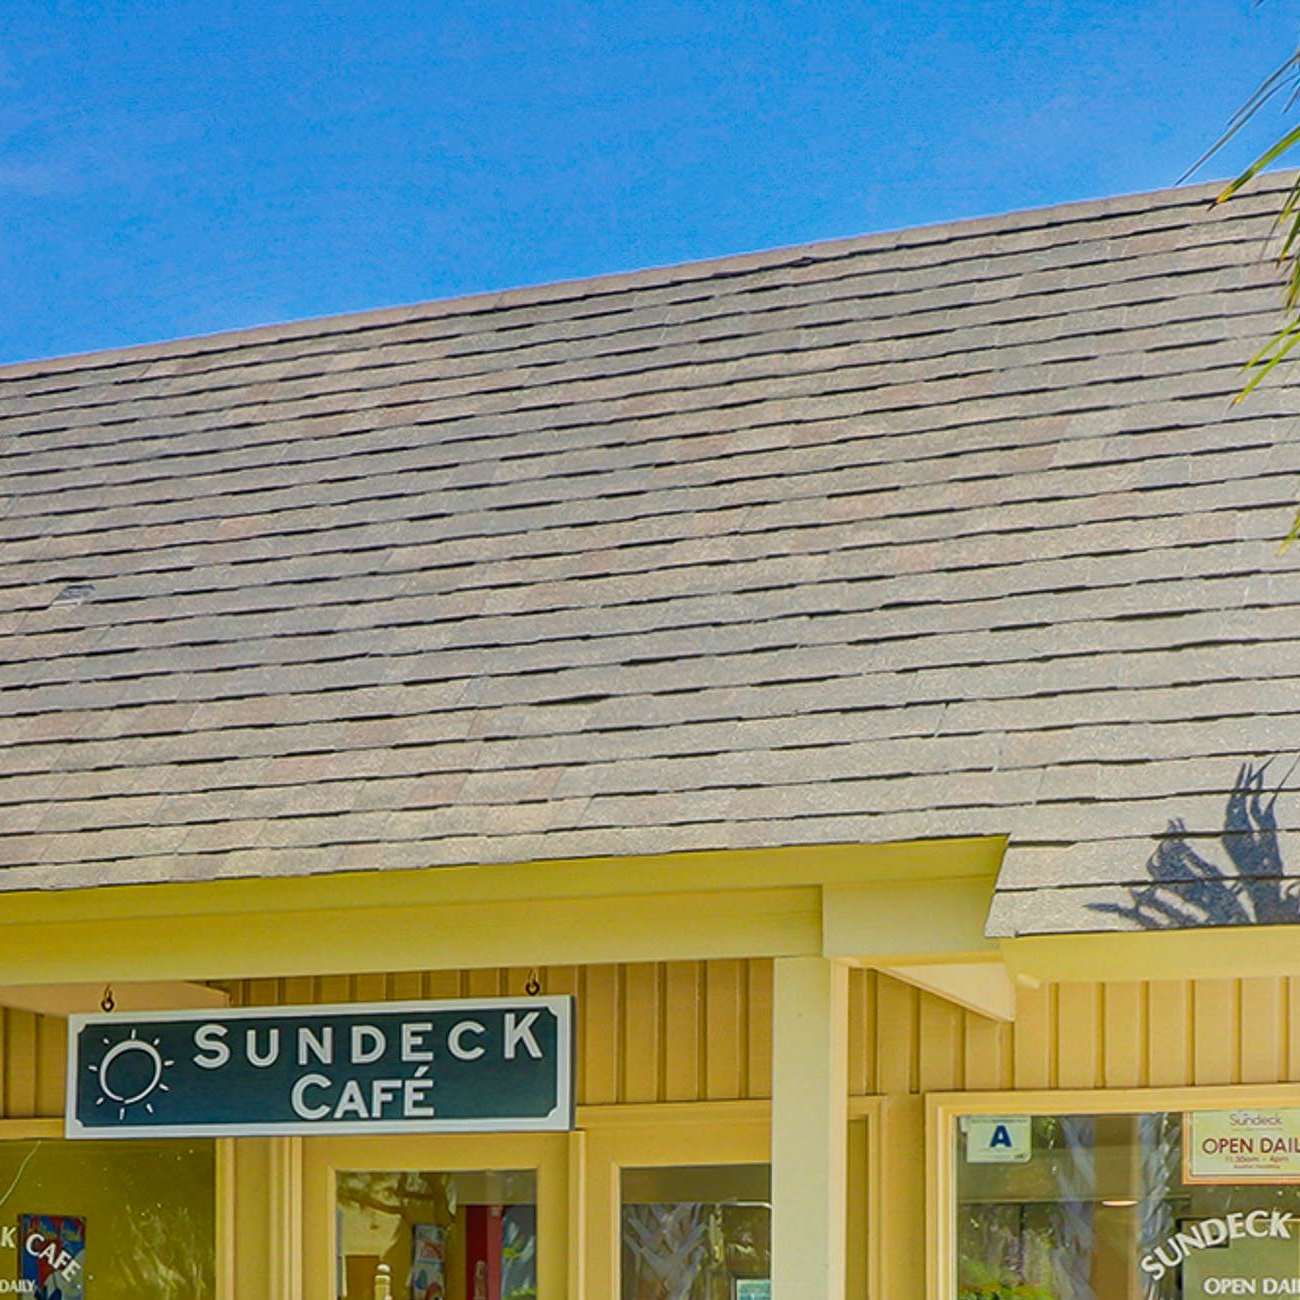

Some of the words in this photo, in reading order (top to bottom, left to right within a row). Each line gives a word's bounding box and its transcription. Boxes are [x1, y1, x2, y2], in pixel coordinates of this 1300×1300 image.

[193, 1011, 543, 1068] SUNDECK
[291, 1067, 434, 1120] CAFÉ
[1229, 1112, 1283, 1127] Sundeck
[989, 1124, 1013, 1148] A
[1202, 1137, 1254, 1155] OPEN
[1140, 1210, 1293, 1281] SUNDECK
[26, 1233, 81, 1283] CAFE
[0, 1279, 36, 1294] DAILY
[1203, 1277, 1258, 1295] OPEN
